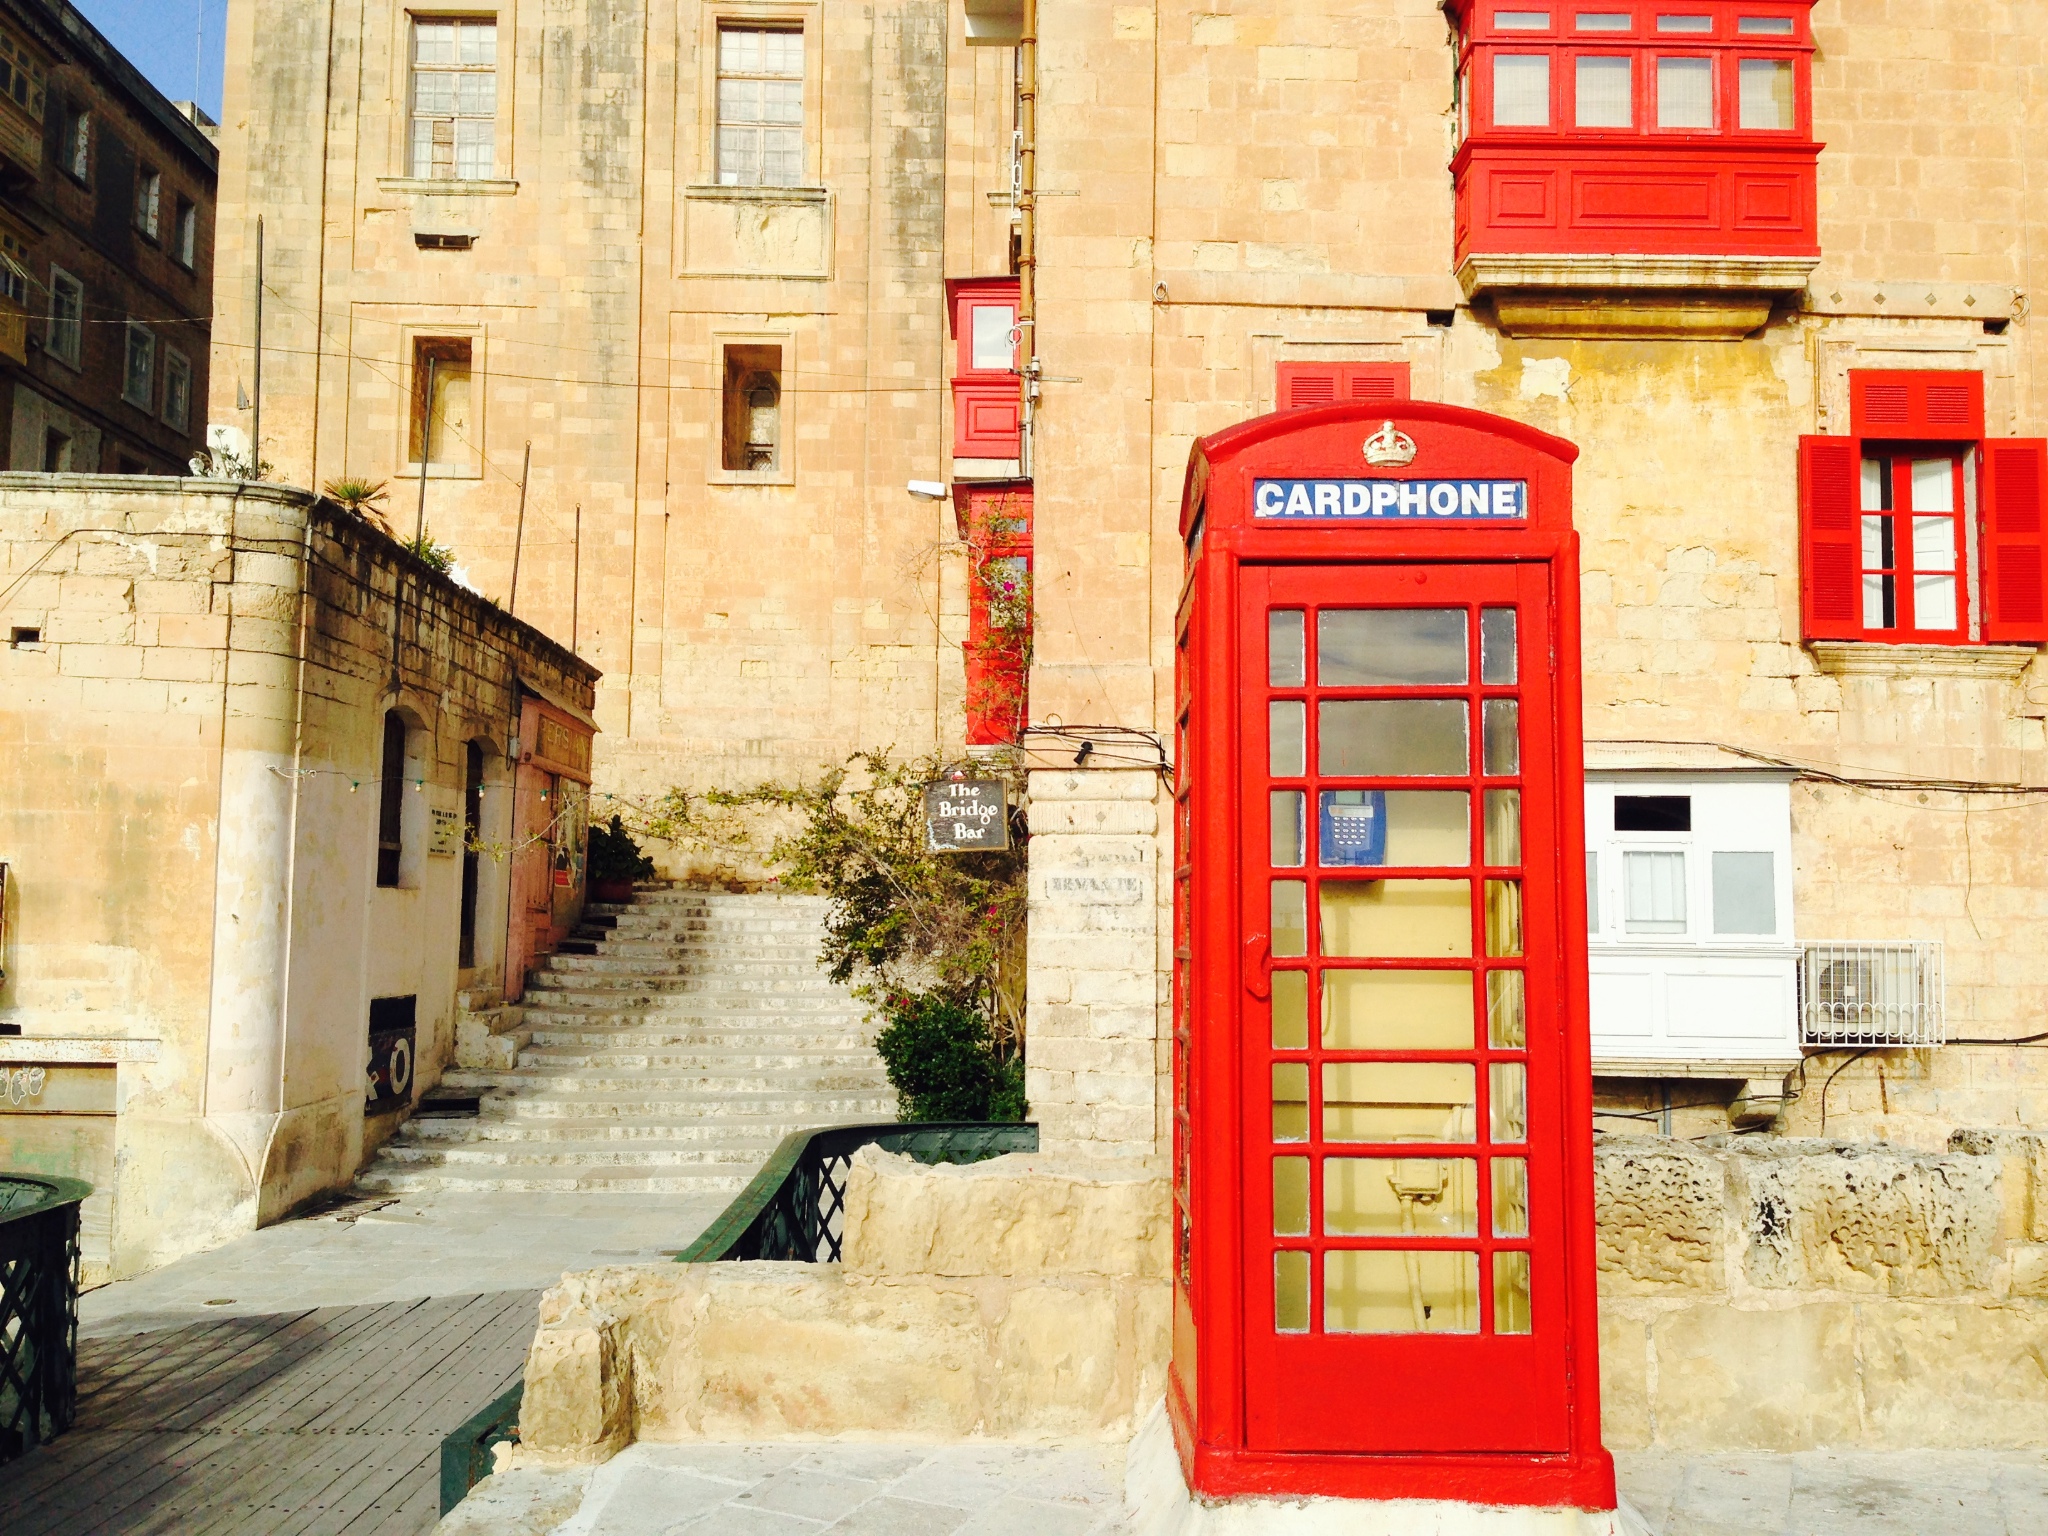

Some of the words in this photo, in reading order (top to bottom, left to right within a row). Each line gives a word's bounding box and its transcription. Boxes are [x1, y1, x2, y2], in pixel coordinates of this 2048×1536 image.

[1256, 483, 1517, 516] CARDPHONE
[949, 784, 981, 797] The
[939, 800, 998, 825] Bridge
[953, 823, 986, 839] Bar
